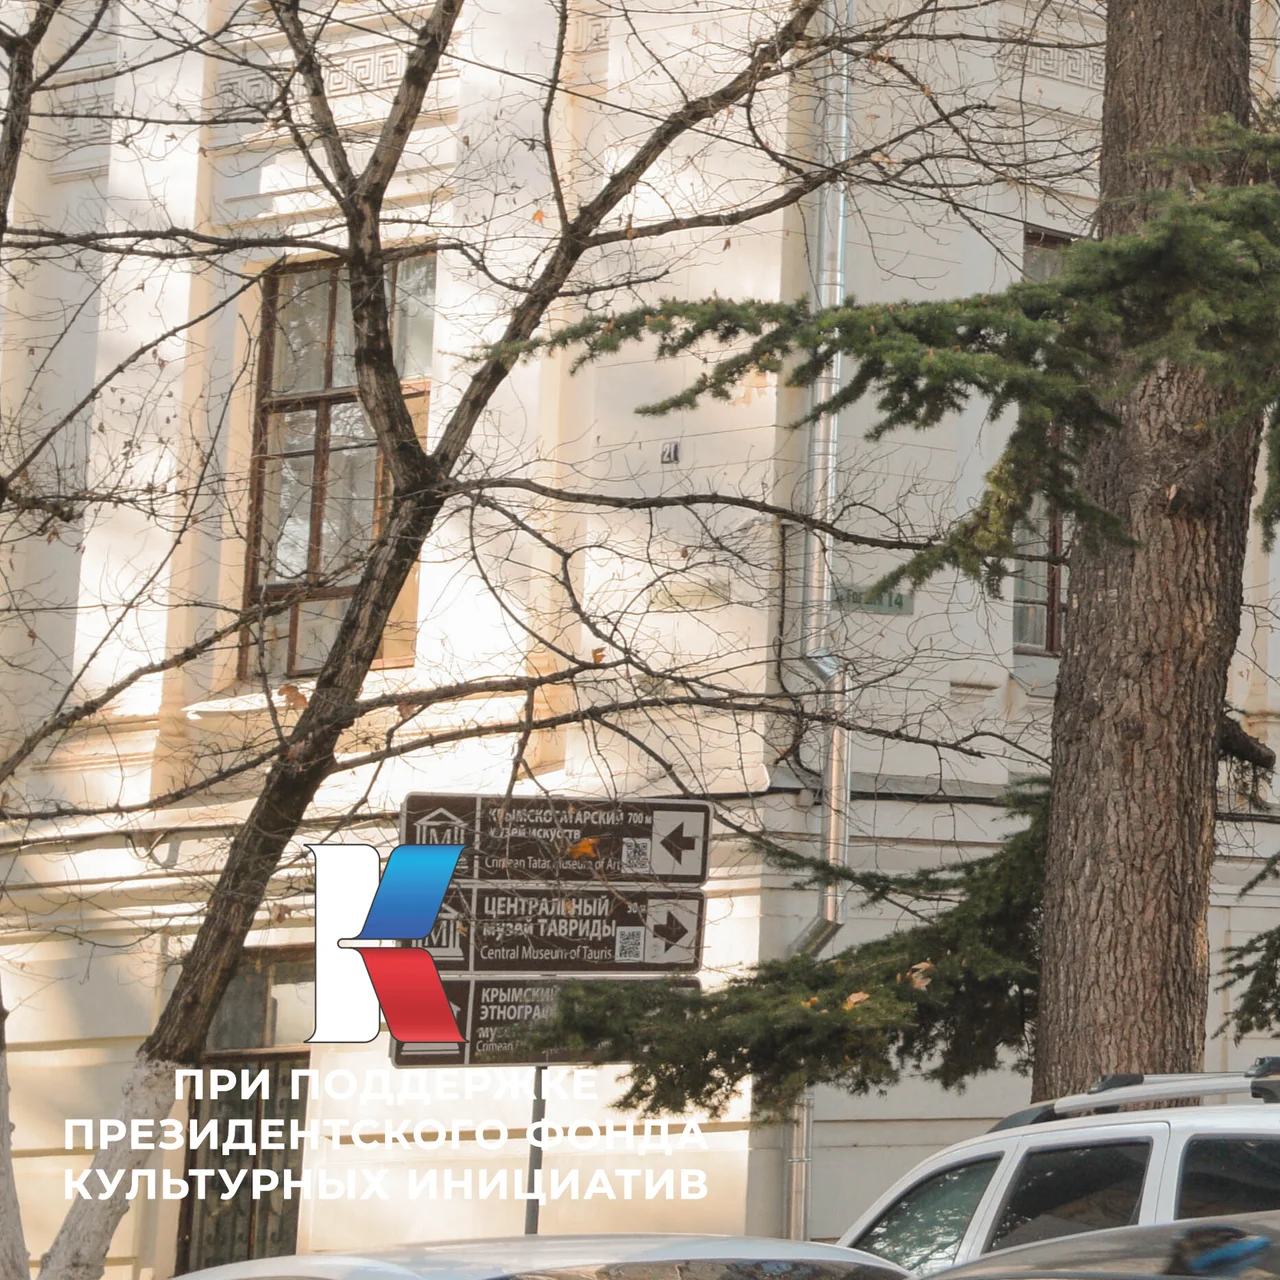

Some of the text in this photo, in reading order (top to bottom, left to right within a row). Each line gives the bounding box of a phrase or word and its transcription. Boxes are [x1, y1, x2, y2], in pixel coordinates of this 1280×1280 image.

[528, 828, 581, 842] искуств
[484, 856, 526, 869] Criean
[539, 919, 616, 941] ТАВРИДЫ
[480, 945, 518, 960] Central
[520, 946, 566, 960] Museum
[583, 946, 612, 960] Tauris
[476, 1040, 514, 1052] Crimean
